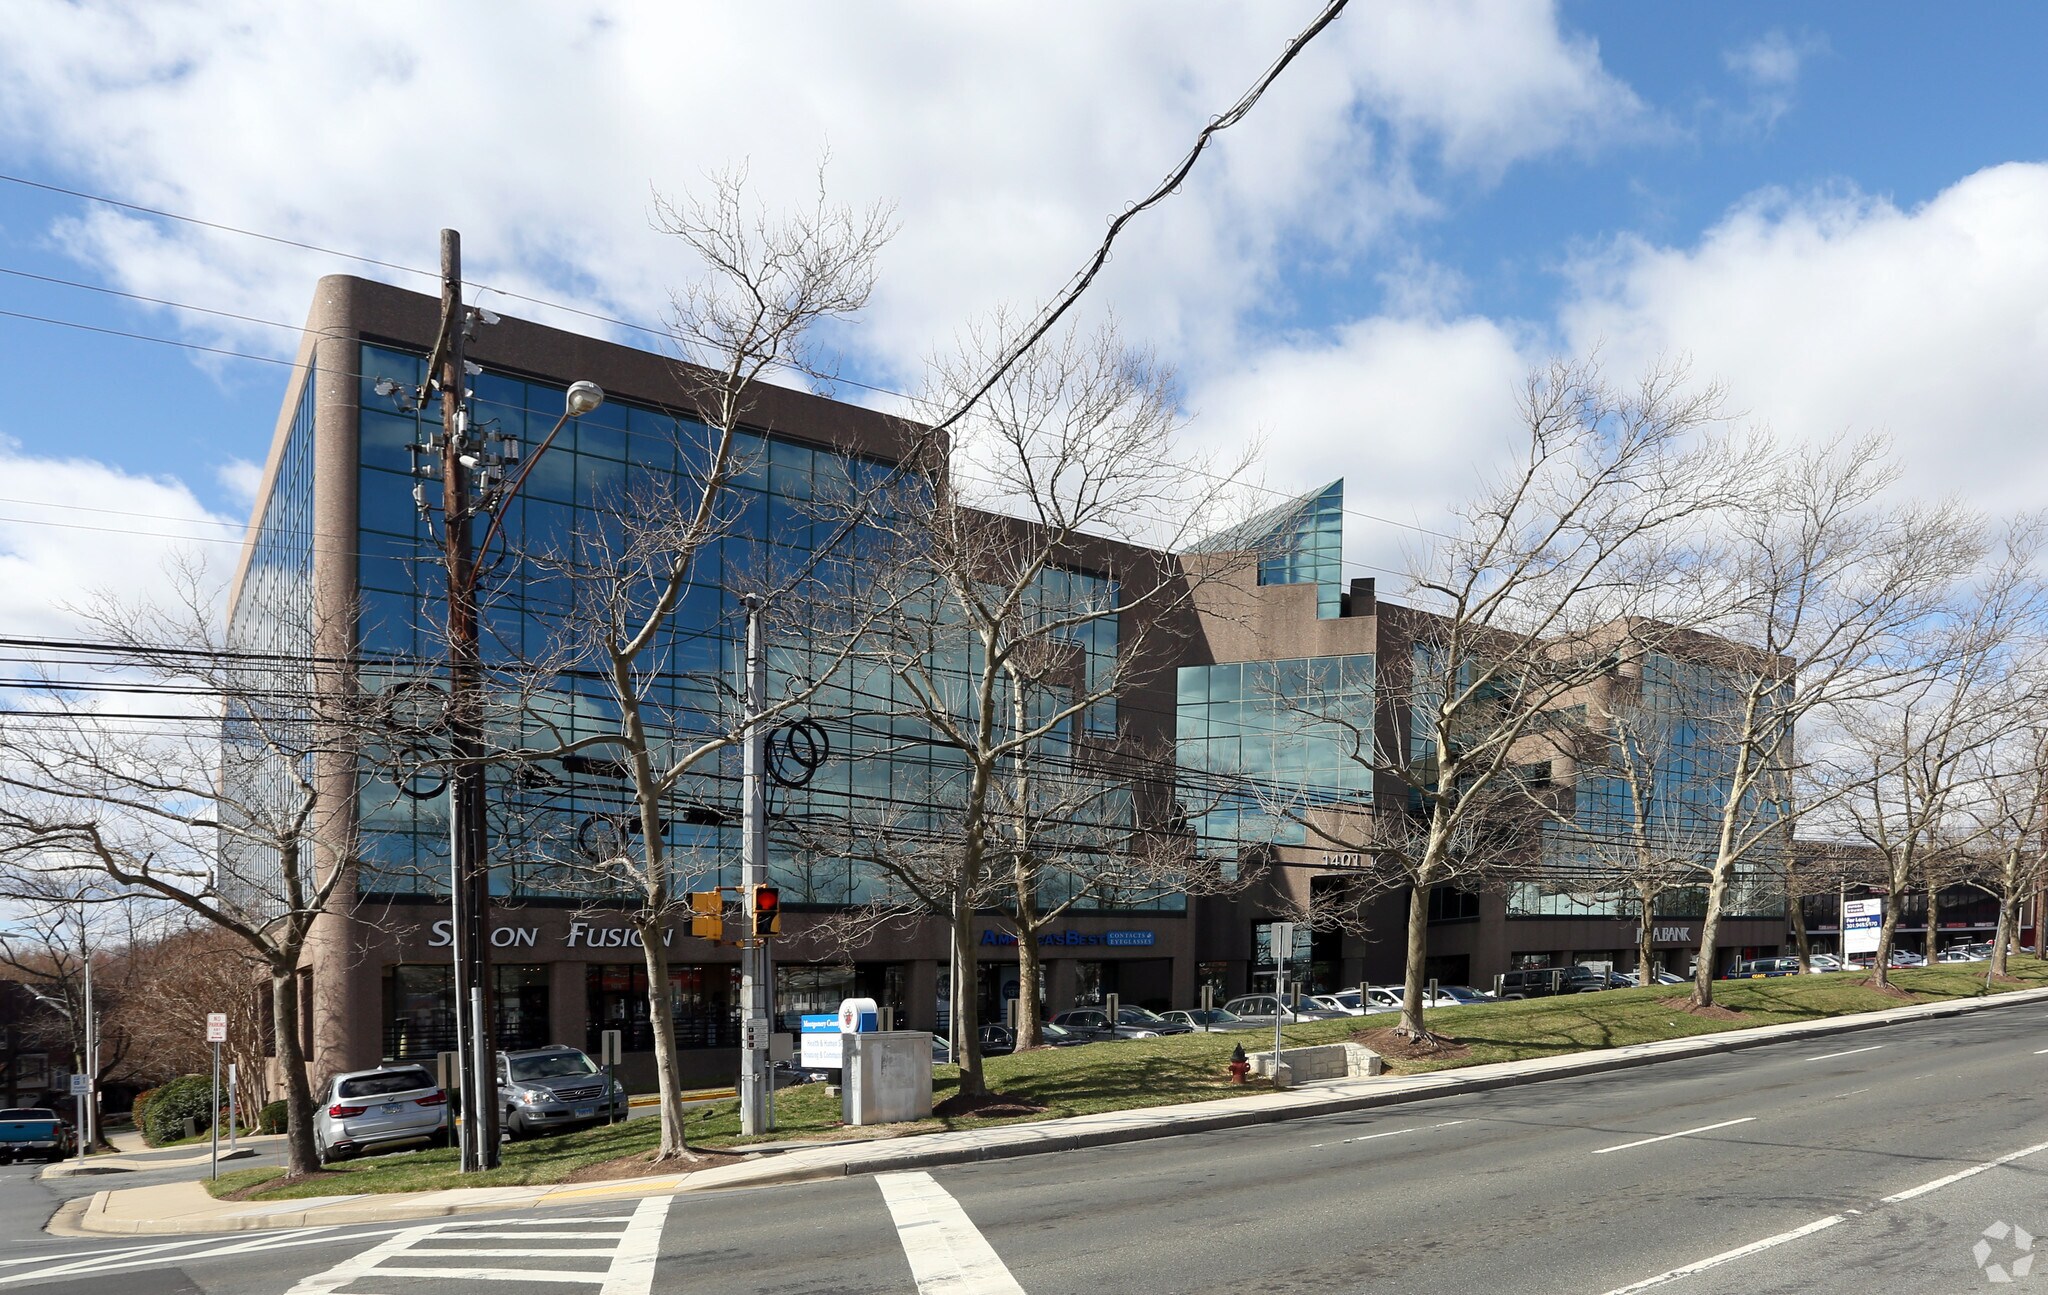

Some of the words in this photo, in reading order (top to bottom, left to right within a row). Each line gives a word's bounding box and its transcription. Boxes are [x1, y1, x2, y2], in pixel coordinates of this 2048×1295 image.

[1323, 853, 1360, 867] 1401
[428, 919, 539, 947] SON
[803, 1020, 826, 1029] Montgomery
